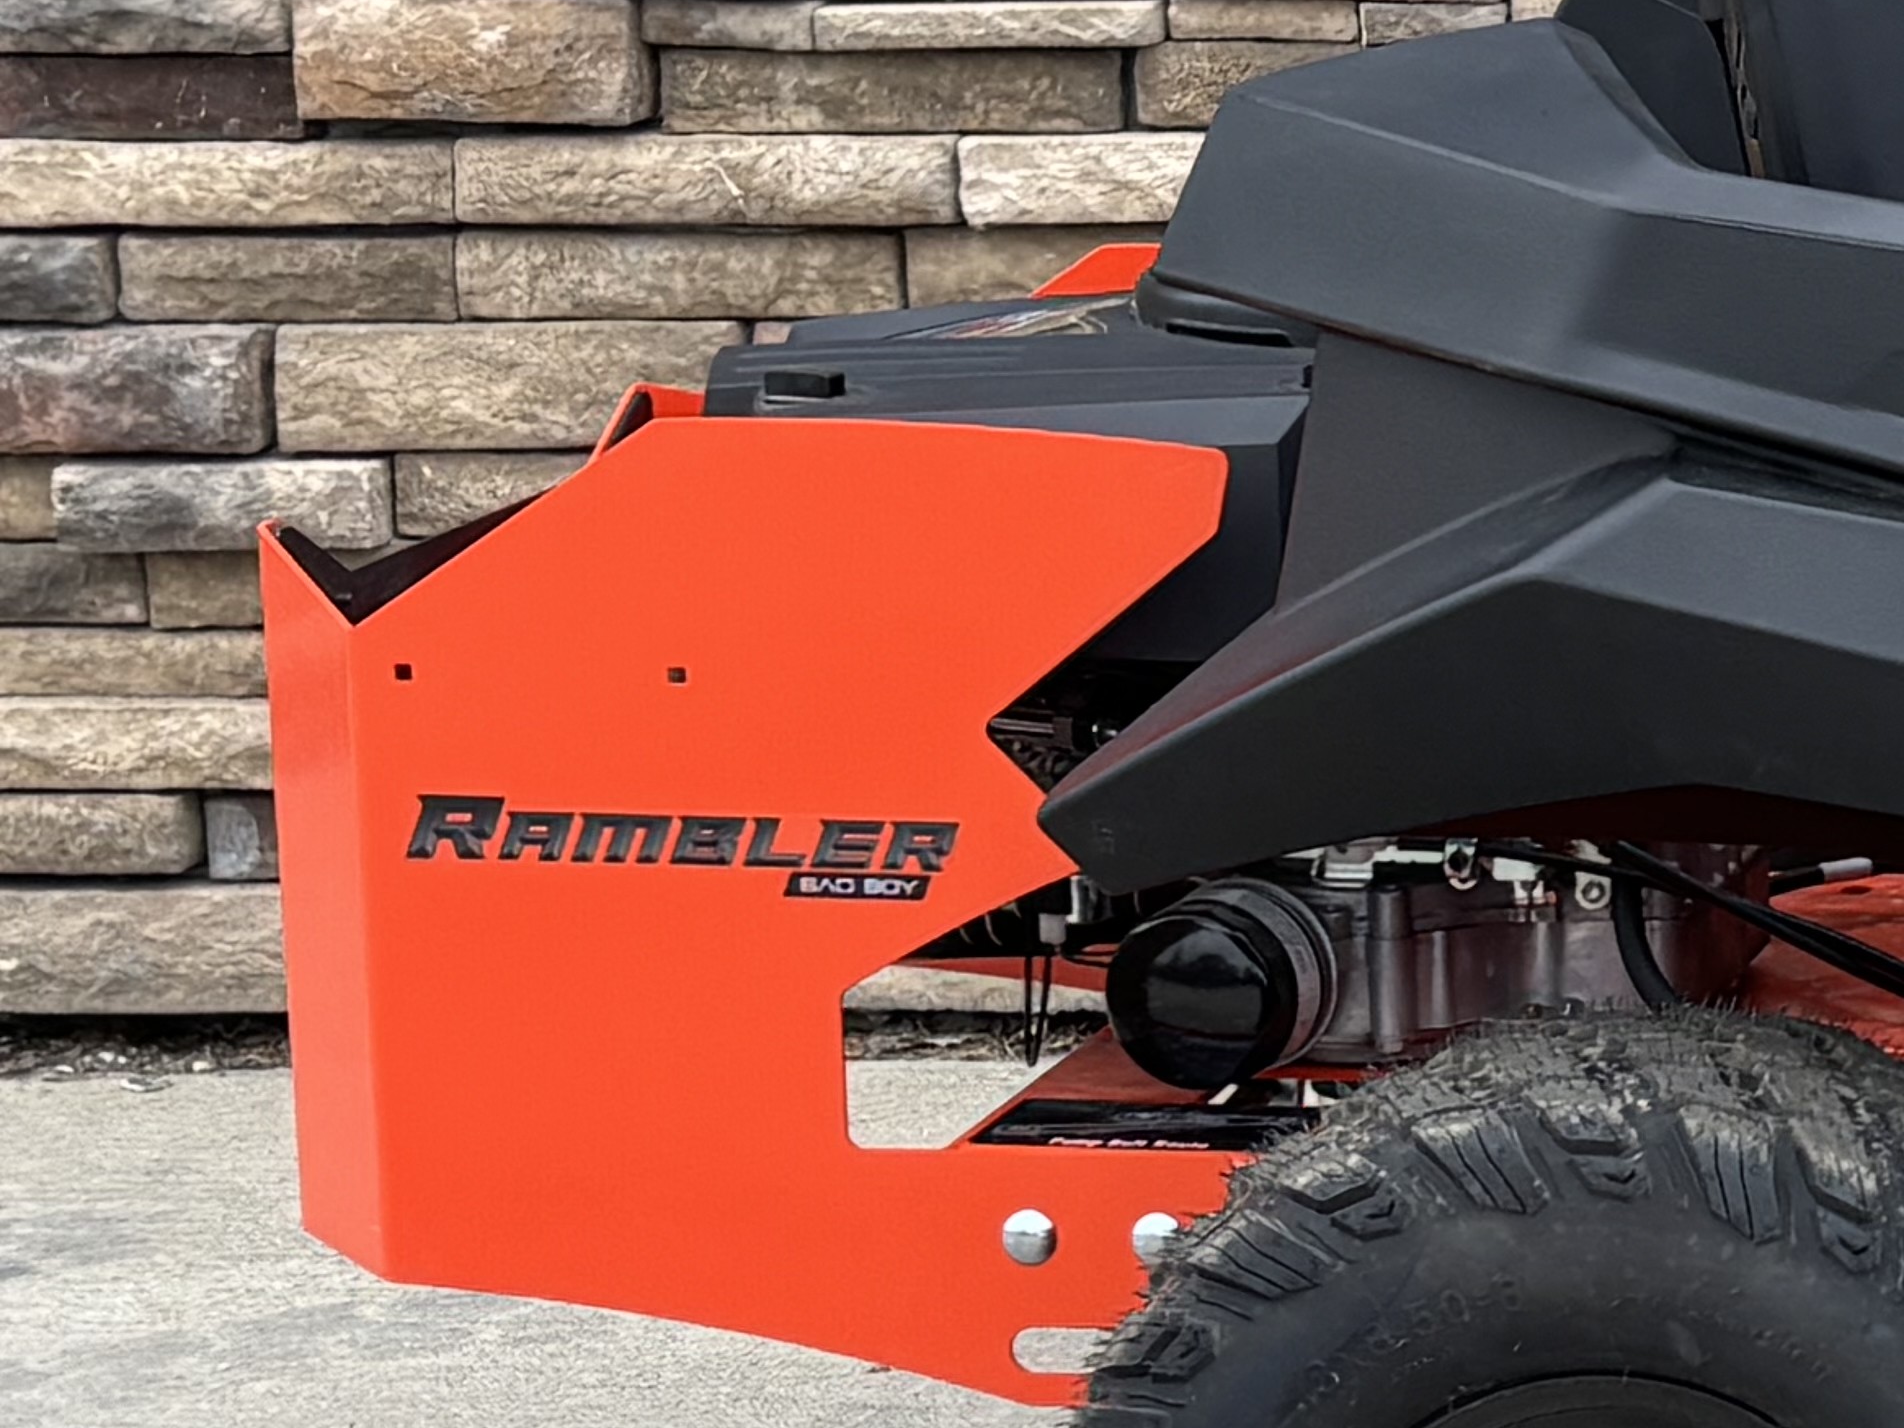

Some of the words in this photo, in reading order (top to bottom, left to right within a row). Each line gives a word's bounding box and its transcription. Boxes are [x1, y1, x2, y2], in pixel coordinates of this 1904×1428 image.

[407, 794, 959, 872] RAMBLER
[800, 876, 855, 893] BAD
[863, 877, 919, 895] BOY
